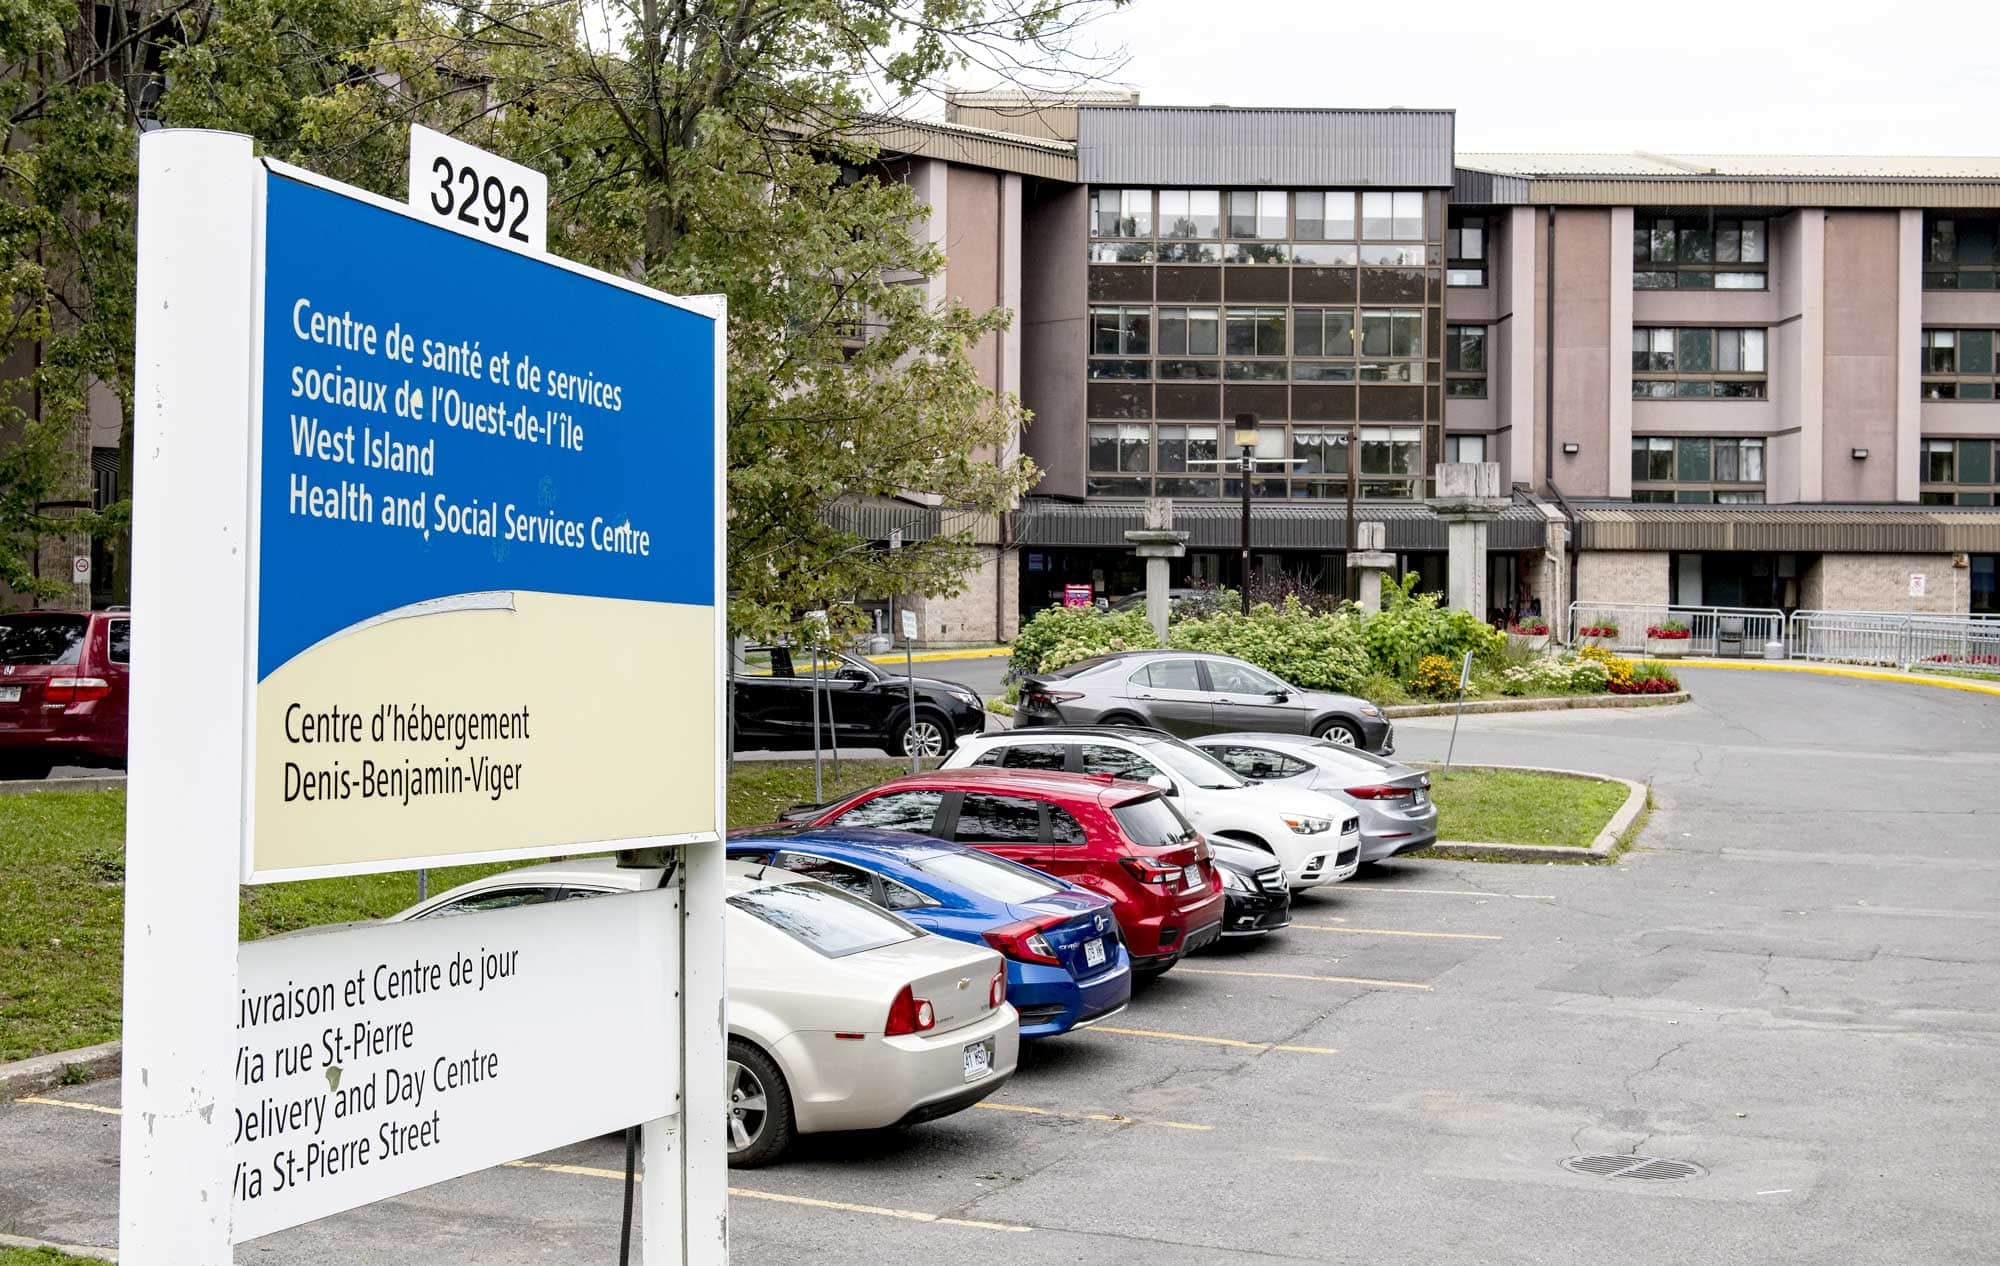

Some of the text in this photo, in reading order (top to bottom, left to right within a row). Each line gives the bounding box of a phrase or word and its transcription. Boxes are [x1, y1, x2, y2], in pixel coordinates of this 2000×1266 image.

[430, 156, 529, 244] 3292
[293, 298, 622, 412] Centre de santé et de services
[290, 414, 434, 476] West Island
[291, 364, 584, 452] sociaux de l'Ouest-de-l'île
[289, 473, 650, 556] Health and Social Services Centre
[284, 702, 530, 751] Centre d'hébergement
[284, 756, 522, 807] Denis-Benjamin-Viger
[236, 947, 519, 1030] ivraison et Centre de jour
[275, 1043, 313, 1078] rue
[322, 1019, 414, 1068] St-Pierre
[334, 1072, 376, 1119] and
[386, 1068, 426, 1108] Day
[433, 1049, 498, 1093] Centre
[273, 1137, 370, 1192] St-Pierre
[379, 1109, 440, 1161] Street
